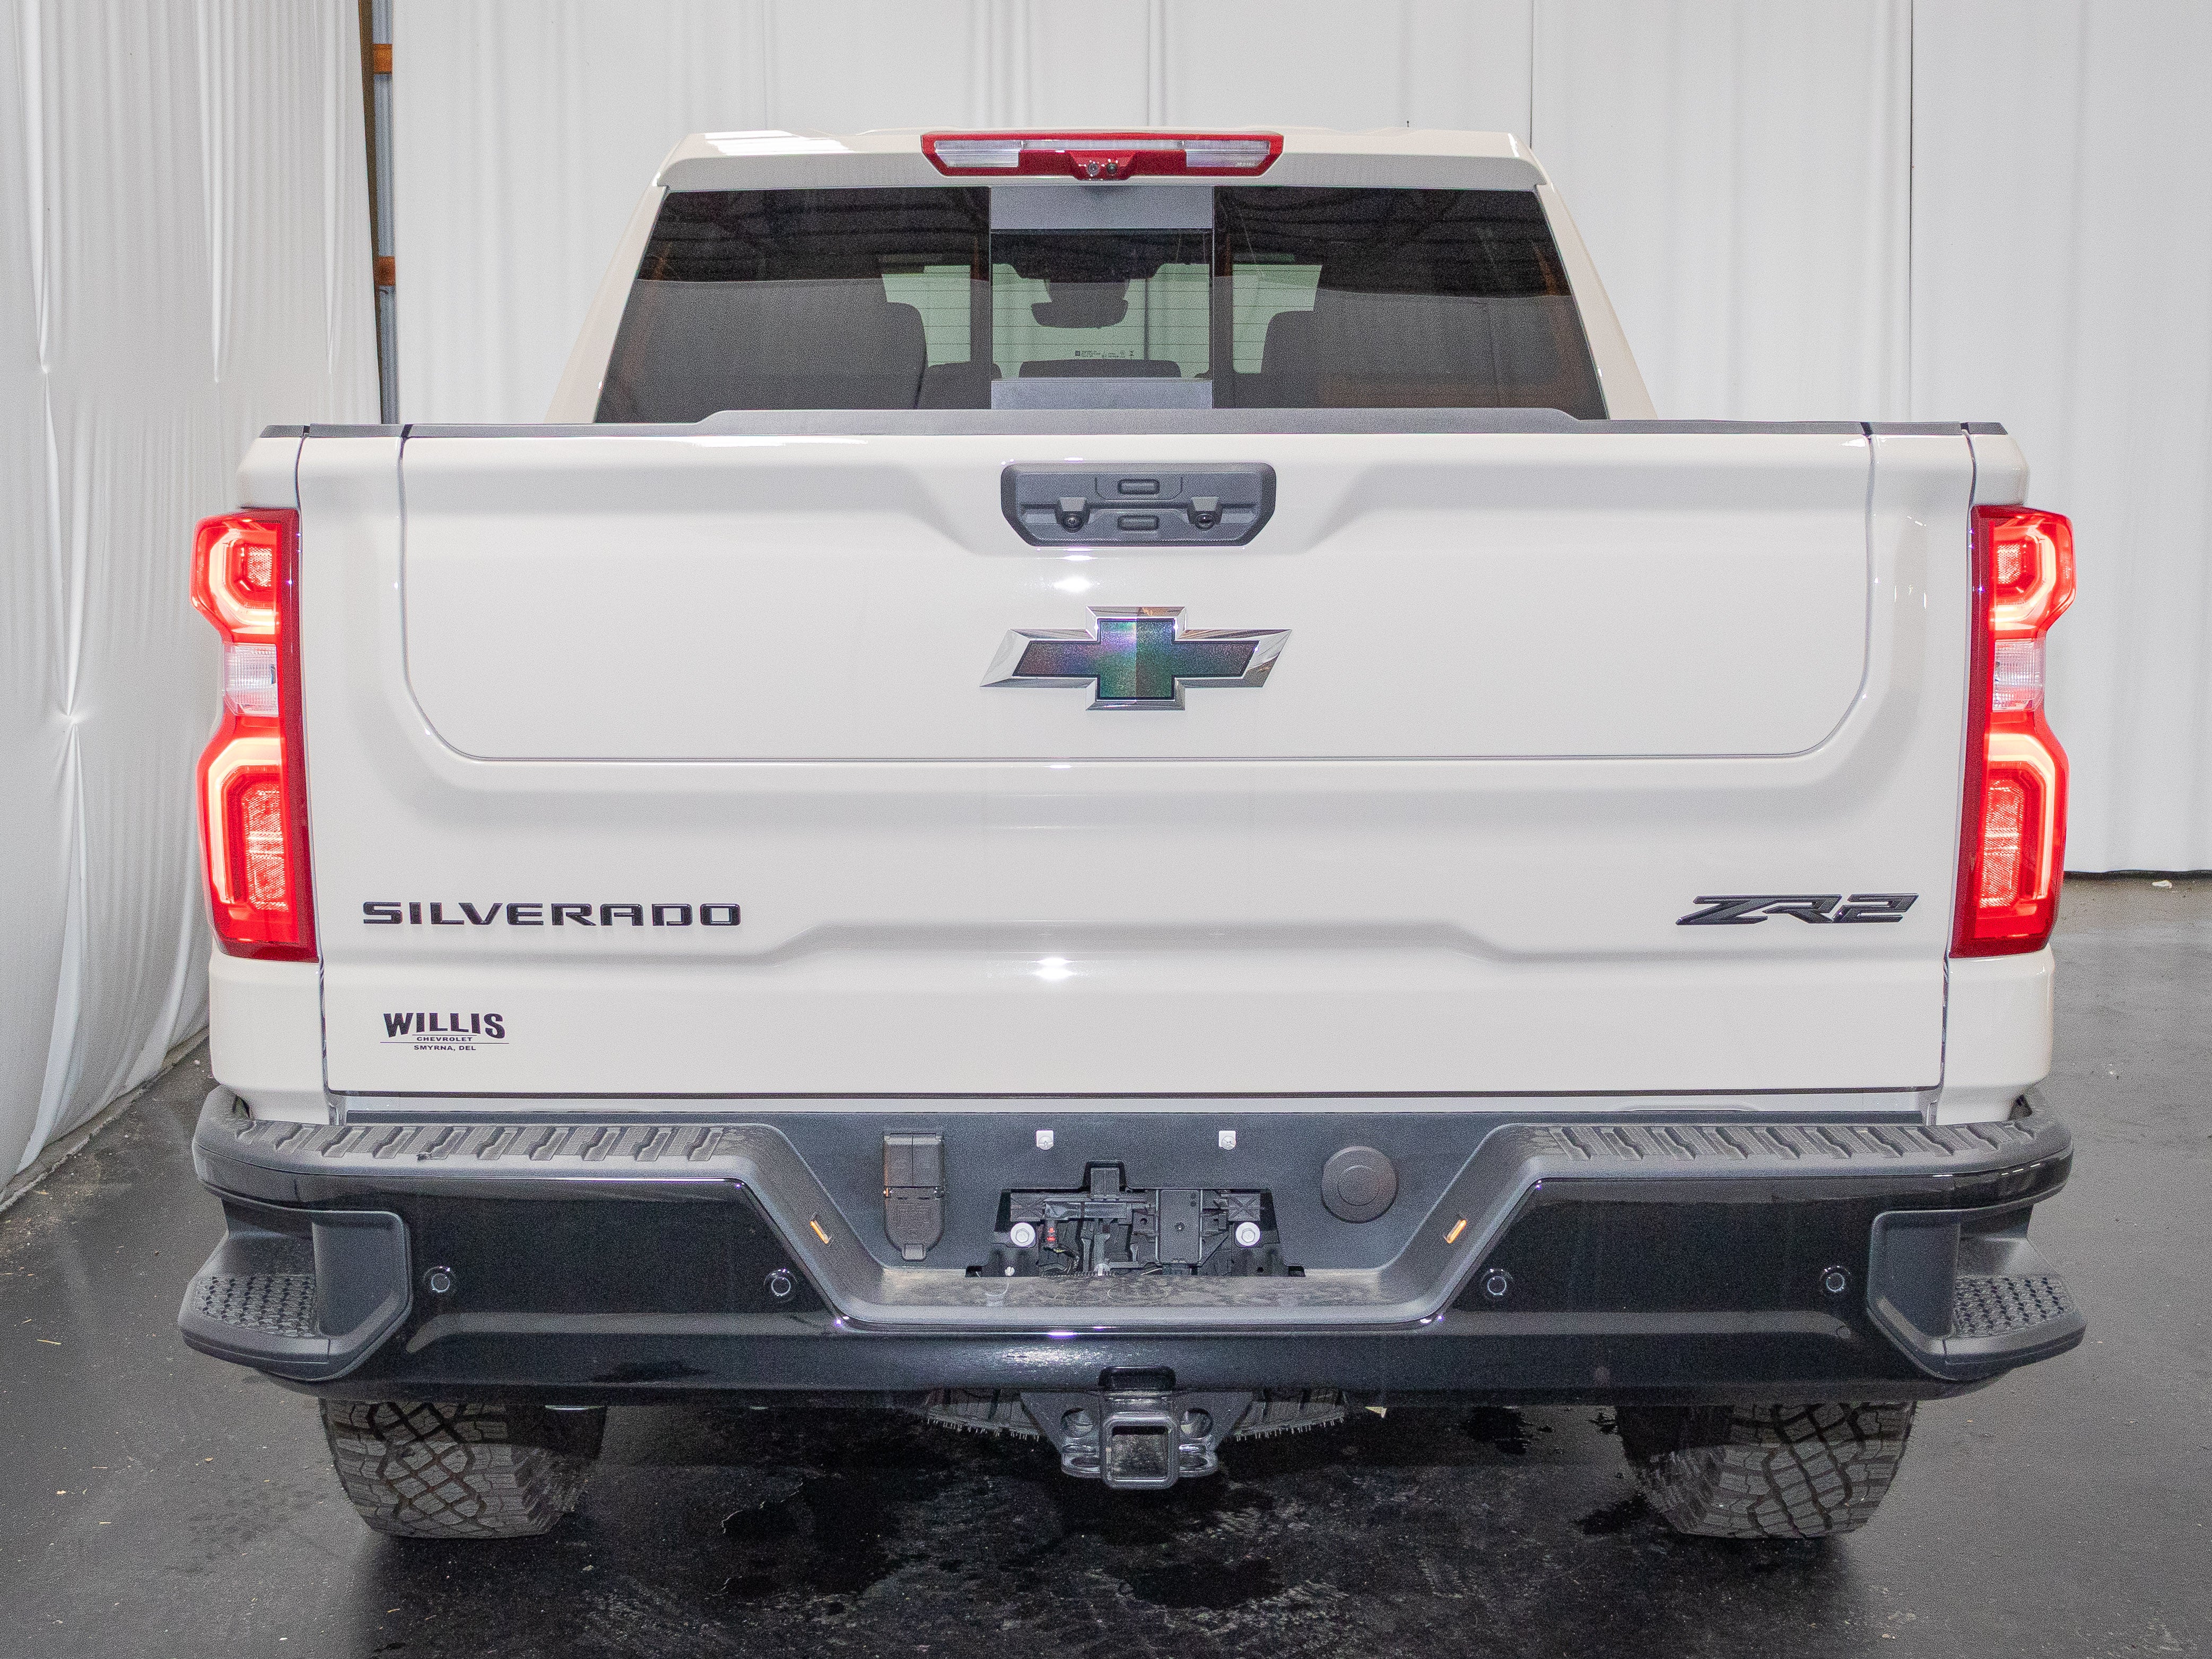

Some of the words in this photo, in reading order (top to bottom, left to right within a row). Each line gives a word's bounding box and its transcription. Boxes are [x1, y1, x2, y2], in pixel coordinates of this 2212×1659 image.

[363, 902, 741, 926] SILVERADO
[1675, 893, 1919, 925] ZR2
[384, 1013, 505, 1038] WILLIS
